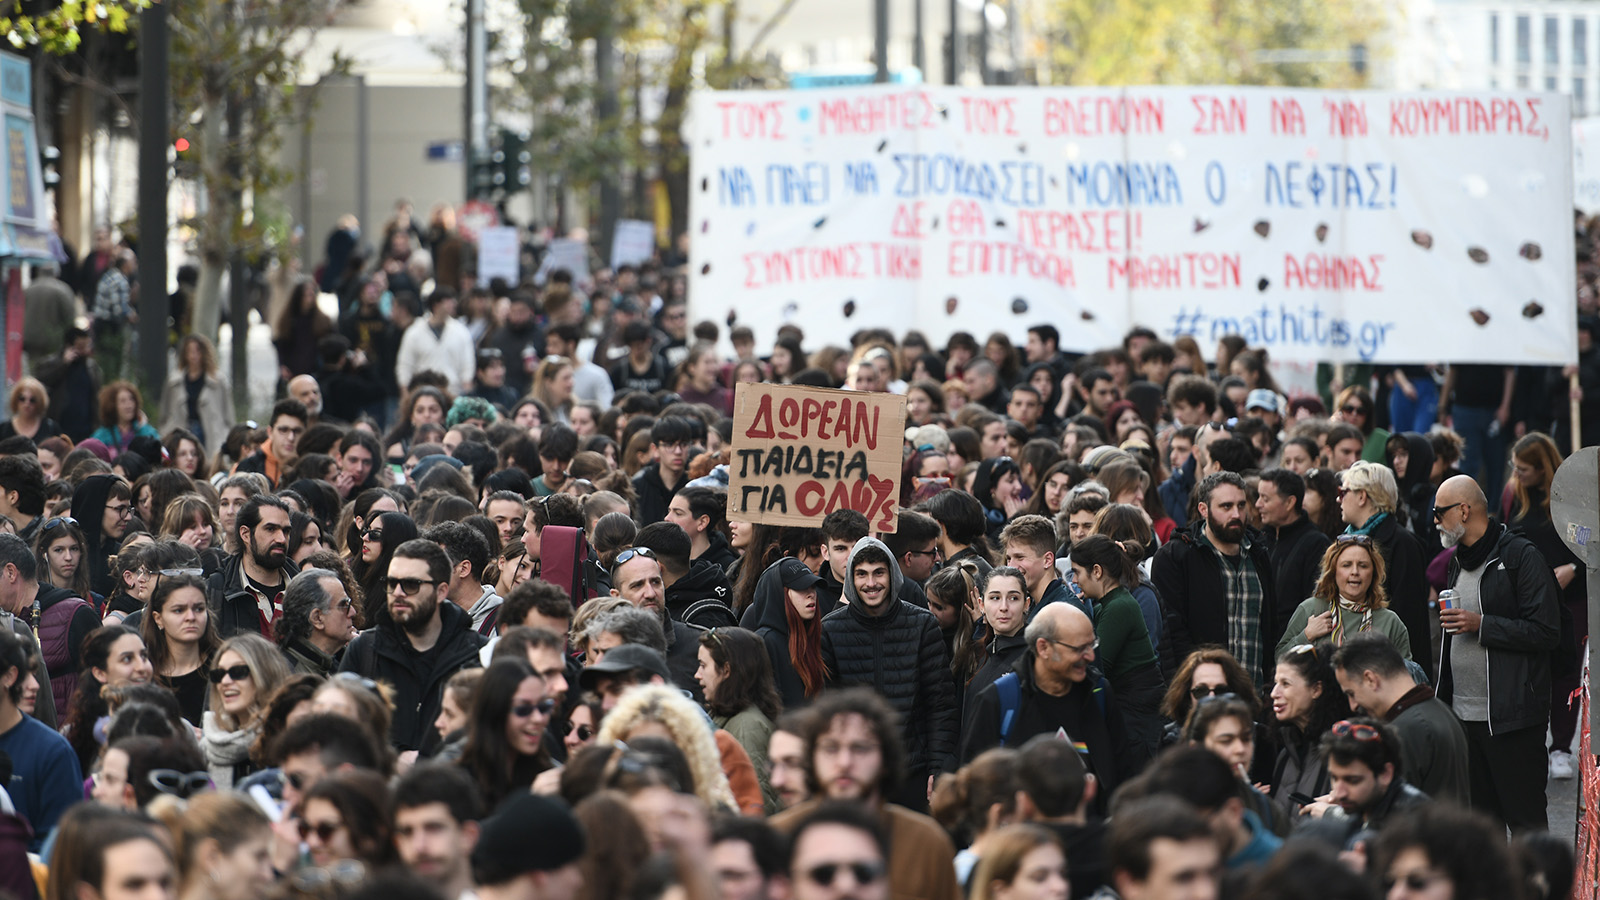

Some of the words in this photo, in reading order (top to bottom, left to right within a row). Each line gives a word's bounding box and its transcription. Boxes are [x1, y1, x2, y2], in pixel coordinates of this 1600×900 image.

[716, 100, 785, 140] ΤΟΥΣ
[819, 92, 936, 135] ΜΑΘΗΤΕΣ
[959, 97, 1020, 136] ΤΟΥΣ
[1043, 97, 1164, 136] ΒΛΕΠΟΥΝ
[1189, 96, 1246, 135] ΣΑΝ
[1271, 97, 1306, 136] ΝΑ
[718, 164, 756, 206] ΝΑ
[766, 162, 830, 206] ΠΑΕΙ
[845, 160, 879, 197] ΝΑ
[893, 153, 1045, 207] ΣΠΟΥΔΑΣΕΙ
[1066, 161, 1182, 207] ΜΟΝΑΧΑ
[1205, 160, 1226, 206] Ο
[1265, 162, 1397, 208] ΛΕΦΤΑΣ!
[891, 201, 927, 238] ΔΕ
[947, 199, 986, 236] ΘΑ
[1017, 210, 1142, 253] ΠΕΡΑΣΕΙ!
[743, 243, 922, 288] ΣΥΝΤΟΝΙΣΤΙΚΗ
[949, 241, 1076, 288] ΕΠΙΤΡΟΠΗ
[1108, 254, 1241, 289] ΜΑΘΗΤΩΝ
[1285, 254, 1385, 291] ΑΘΗΝΑΣ
[746, 394, 880, 450] ΔΩΡΕΑΝ
[737, 445, 868, 482] ΠΑΙΔΕΙΑ
[740, 484, 787, 514] ΓΙΑ
